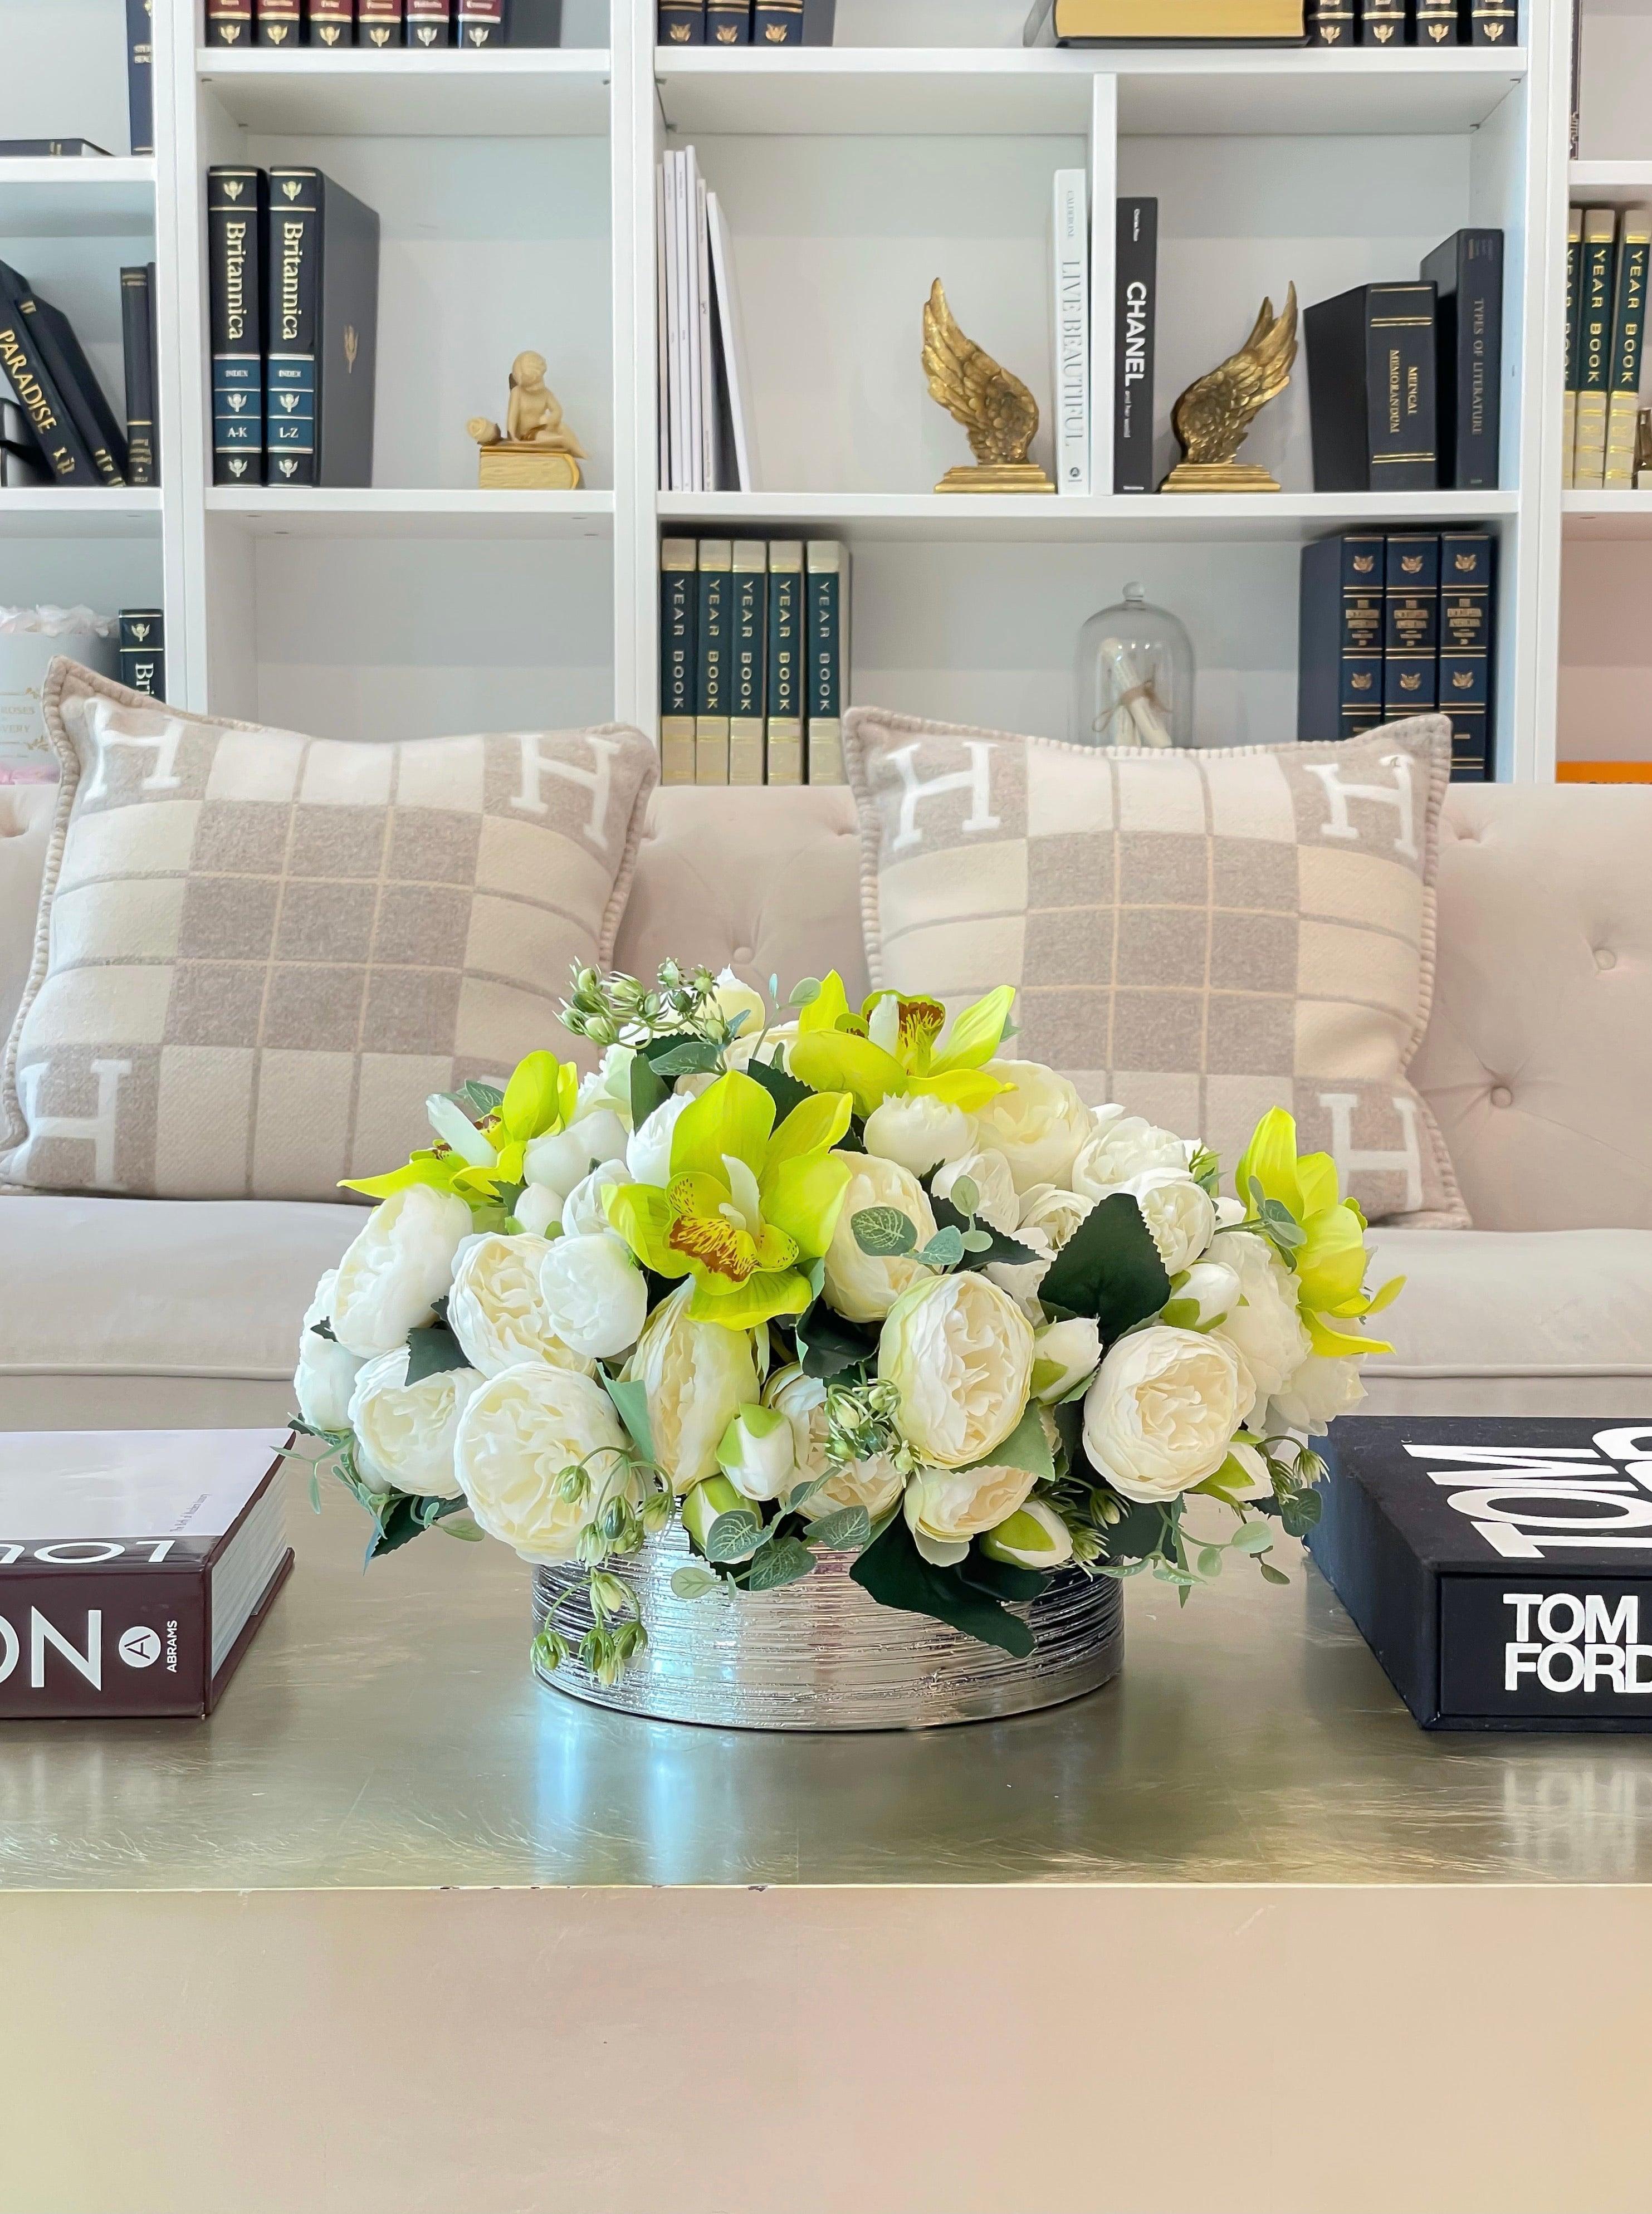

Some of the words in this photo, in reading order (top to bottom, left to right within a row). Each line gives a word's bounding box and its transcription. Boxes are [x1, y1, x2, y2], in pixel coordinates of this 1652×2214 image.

[226, 222, 246, 340] Britannica
[282, 222, 304, 340] Britannica
[1062, 260, 1082, 312] LIVE
[1591, 250, 1607, 308] YEAR
[1627, 250, 1644, 309] YEAR
[1125, 281, 1147, 387] CHANEL
[1473, 297, 1484, 335] TYPES
[1473, 340, 1484, 357] OF
[1587, 322, 1603, 383] BOOK
[1621, 323, 1638, 383] BOOK
[0, 329, 57, 434] PARADISE
[1063, 319, 1083, 447] BEAUTIFUL
[1389, 349, 1400, 433] MEMORANDUM
[1472, 361, 1484, 434] LITERATURE
[227, 427, 248, 438] A-K
[279, 427, 299, 438] L-Z
[673, 579, 685, 636] YEAR
[708, 579, 720, 636] YEAR
[741, 580, 753, 638] YEAR
[779, 580, 790, 638] YEAR
[819, 581, 830, 638] YEAR
[673, 651, 685, 708] BOOK
[708, 651, 720, 710] BOOK
[741, 652, 753, 711] BOOK
[779, 652, 790, 711] BOOK
[819, 652, 830, 711] BOOK
[887, 741, 1001, 848] H
[1302, 754, 1419, 861] H
[166, 1619, 178, 1673] ABRAMS
[1503, 1593, 1639, 1644] TOM
[0, 1605, 102, 1692] N
[1504, 1641, 1652, 1693] FORD
